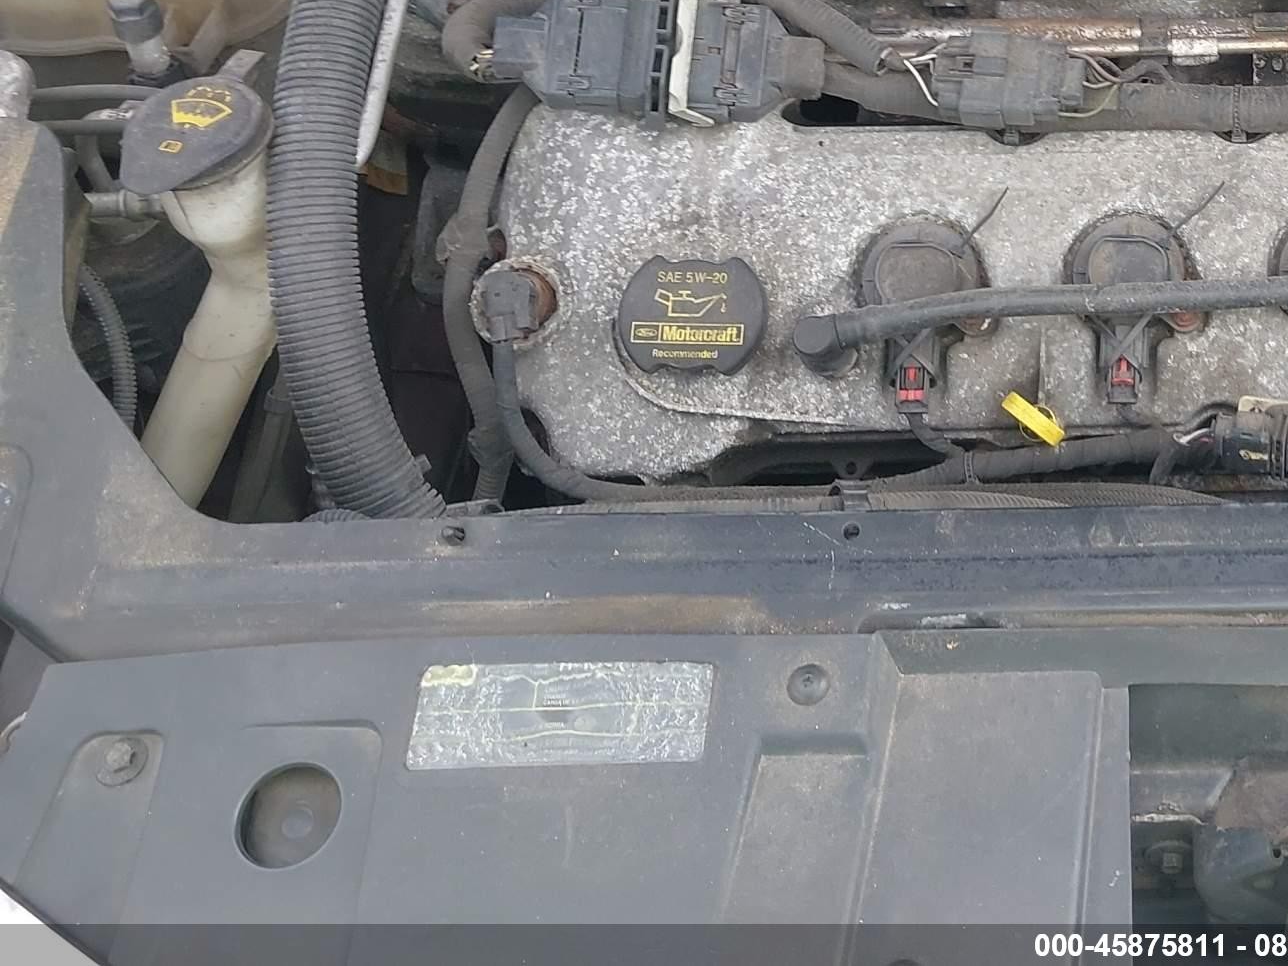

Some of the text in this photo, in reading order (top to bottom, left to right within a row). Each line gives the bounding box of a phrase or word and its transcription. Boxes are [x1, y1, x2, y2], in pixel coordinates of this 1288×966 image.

[657, 271, 728, 284] SAE 5W-20
[663, 325, 738, 342] Motorcraft
[652, 348, 718, 359] Recommended
